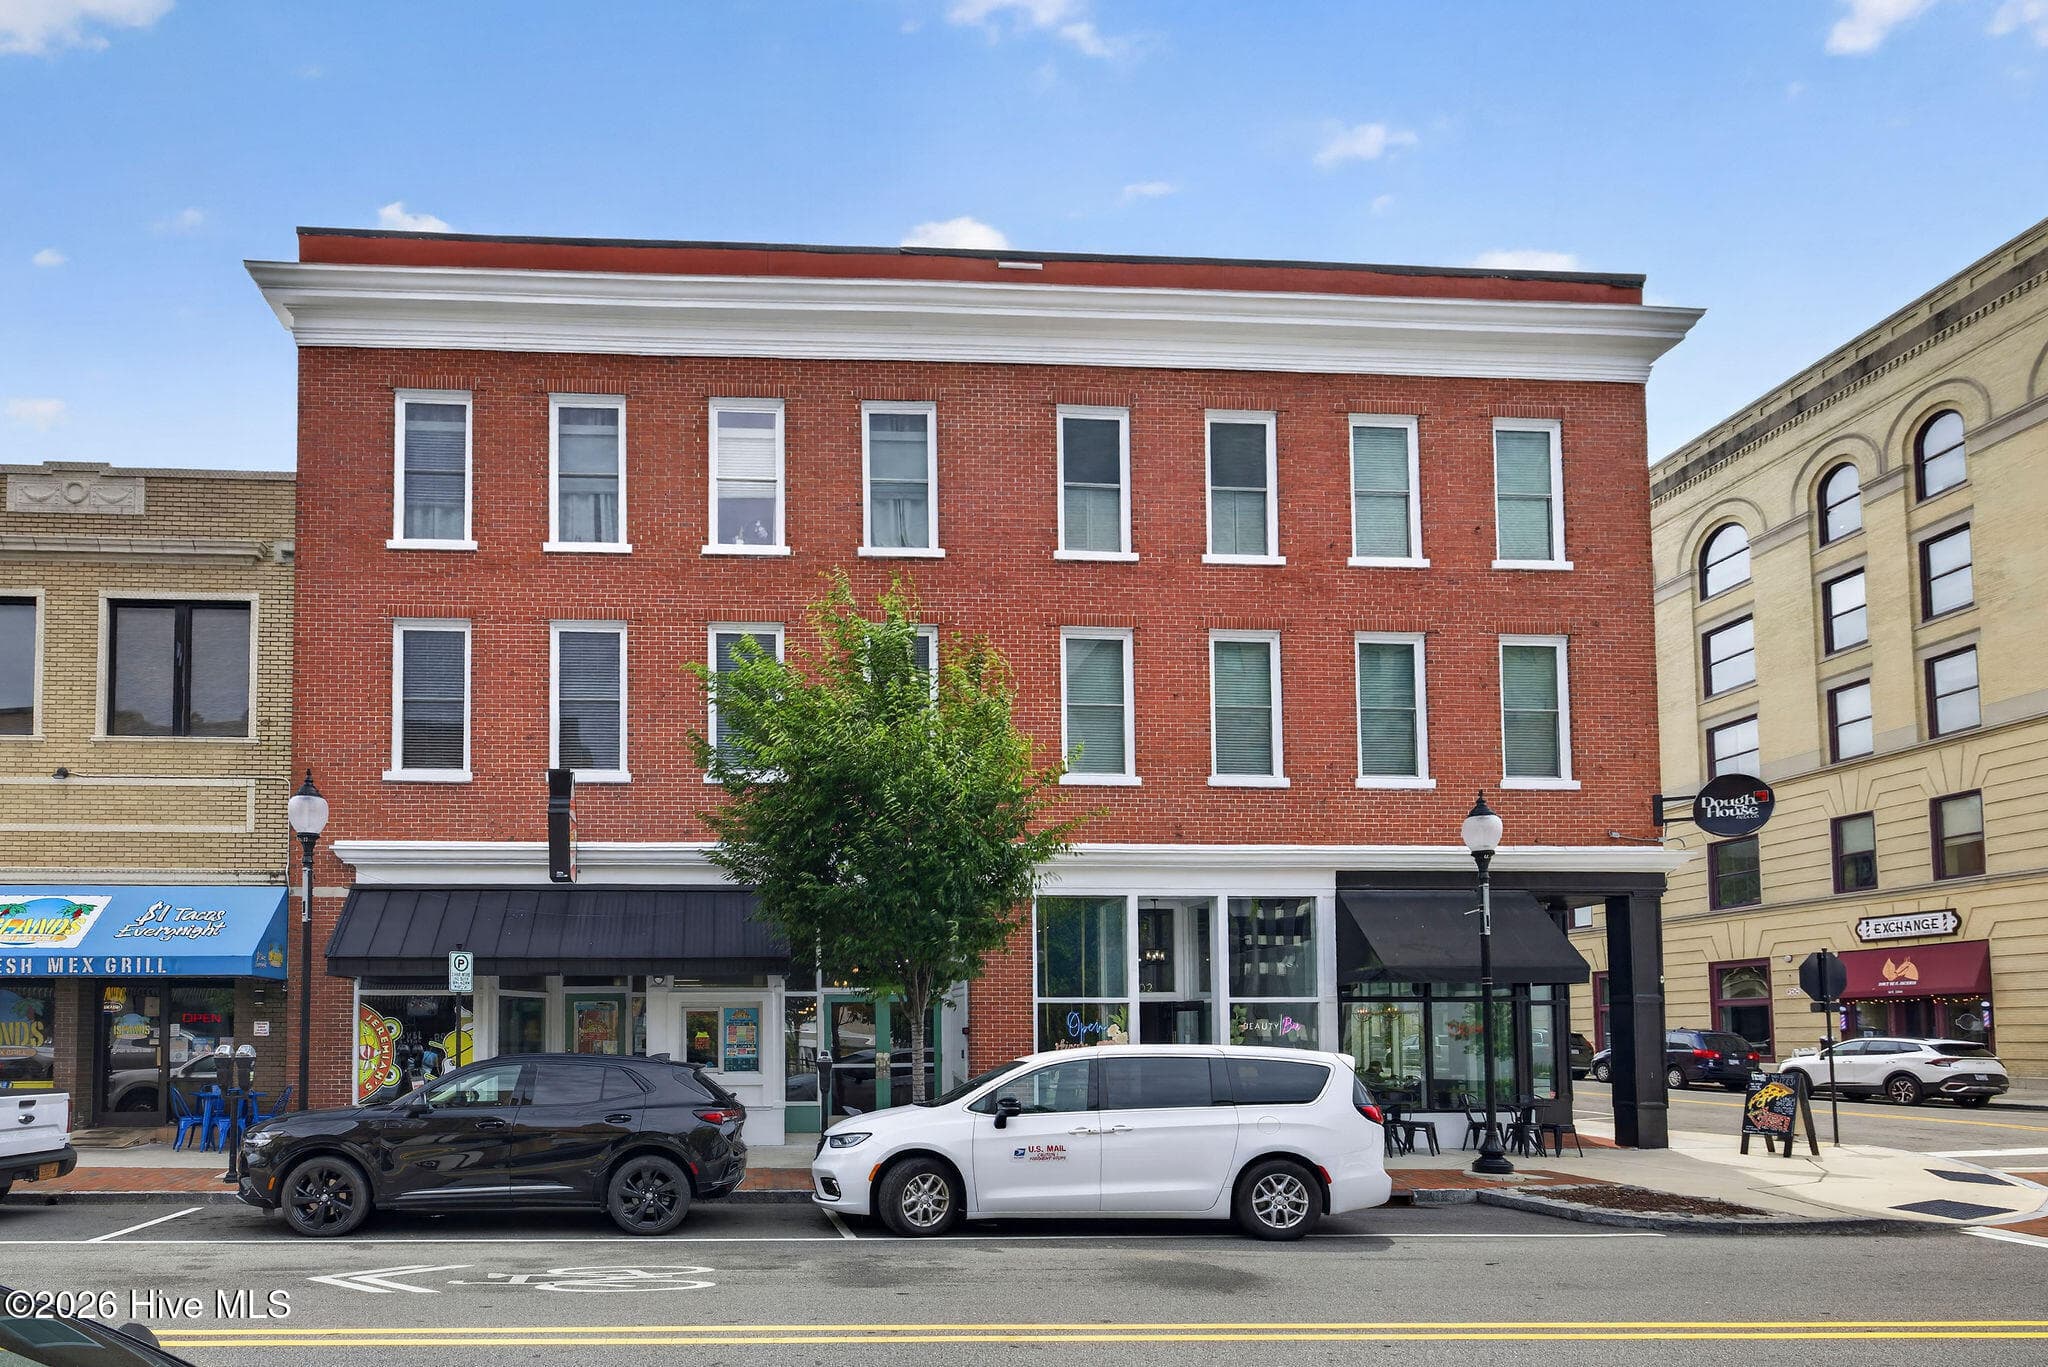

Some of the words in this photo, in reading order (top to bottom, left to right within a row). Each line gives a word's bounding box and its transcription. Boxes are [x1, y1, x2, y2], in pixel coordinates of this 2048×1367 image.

[1701, 794, 1758, 808] Dough
[1706, 805, 1759, 818] House
[135, 900, 172, 926] $1
[174, 906, 226, 921] Tacos
[0, 917, 87, 936] LANDS
[1873, 917, 1940, 935] EXCHANGE
[0, 957, 32, 974] SH
[47, 957, 94, 974] MEX
[105, 957, 167, 974] GRILL
[182, 1012, 223, 1024] OPEN
[1067, 1011, 1108, 1043] Open
[365, 1013, 390, 1092] JEREMIAH'S
[1028, 1145, 1044, 1153] U.S.
[1046, 1144, 1067, 1153] MAIL
